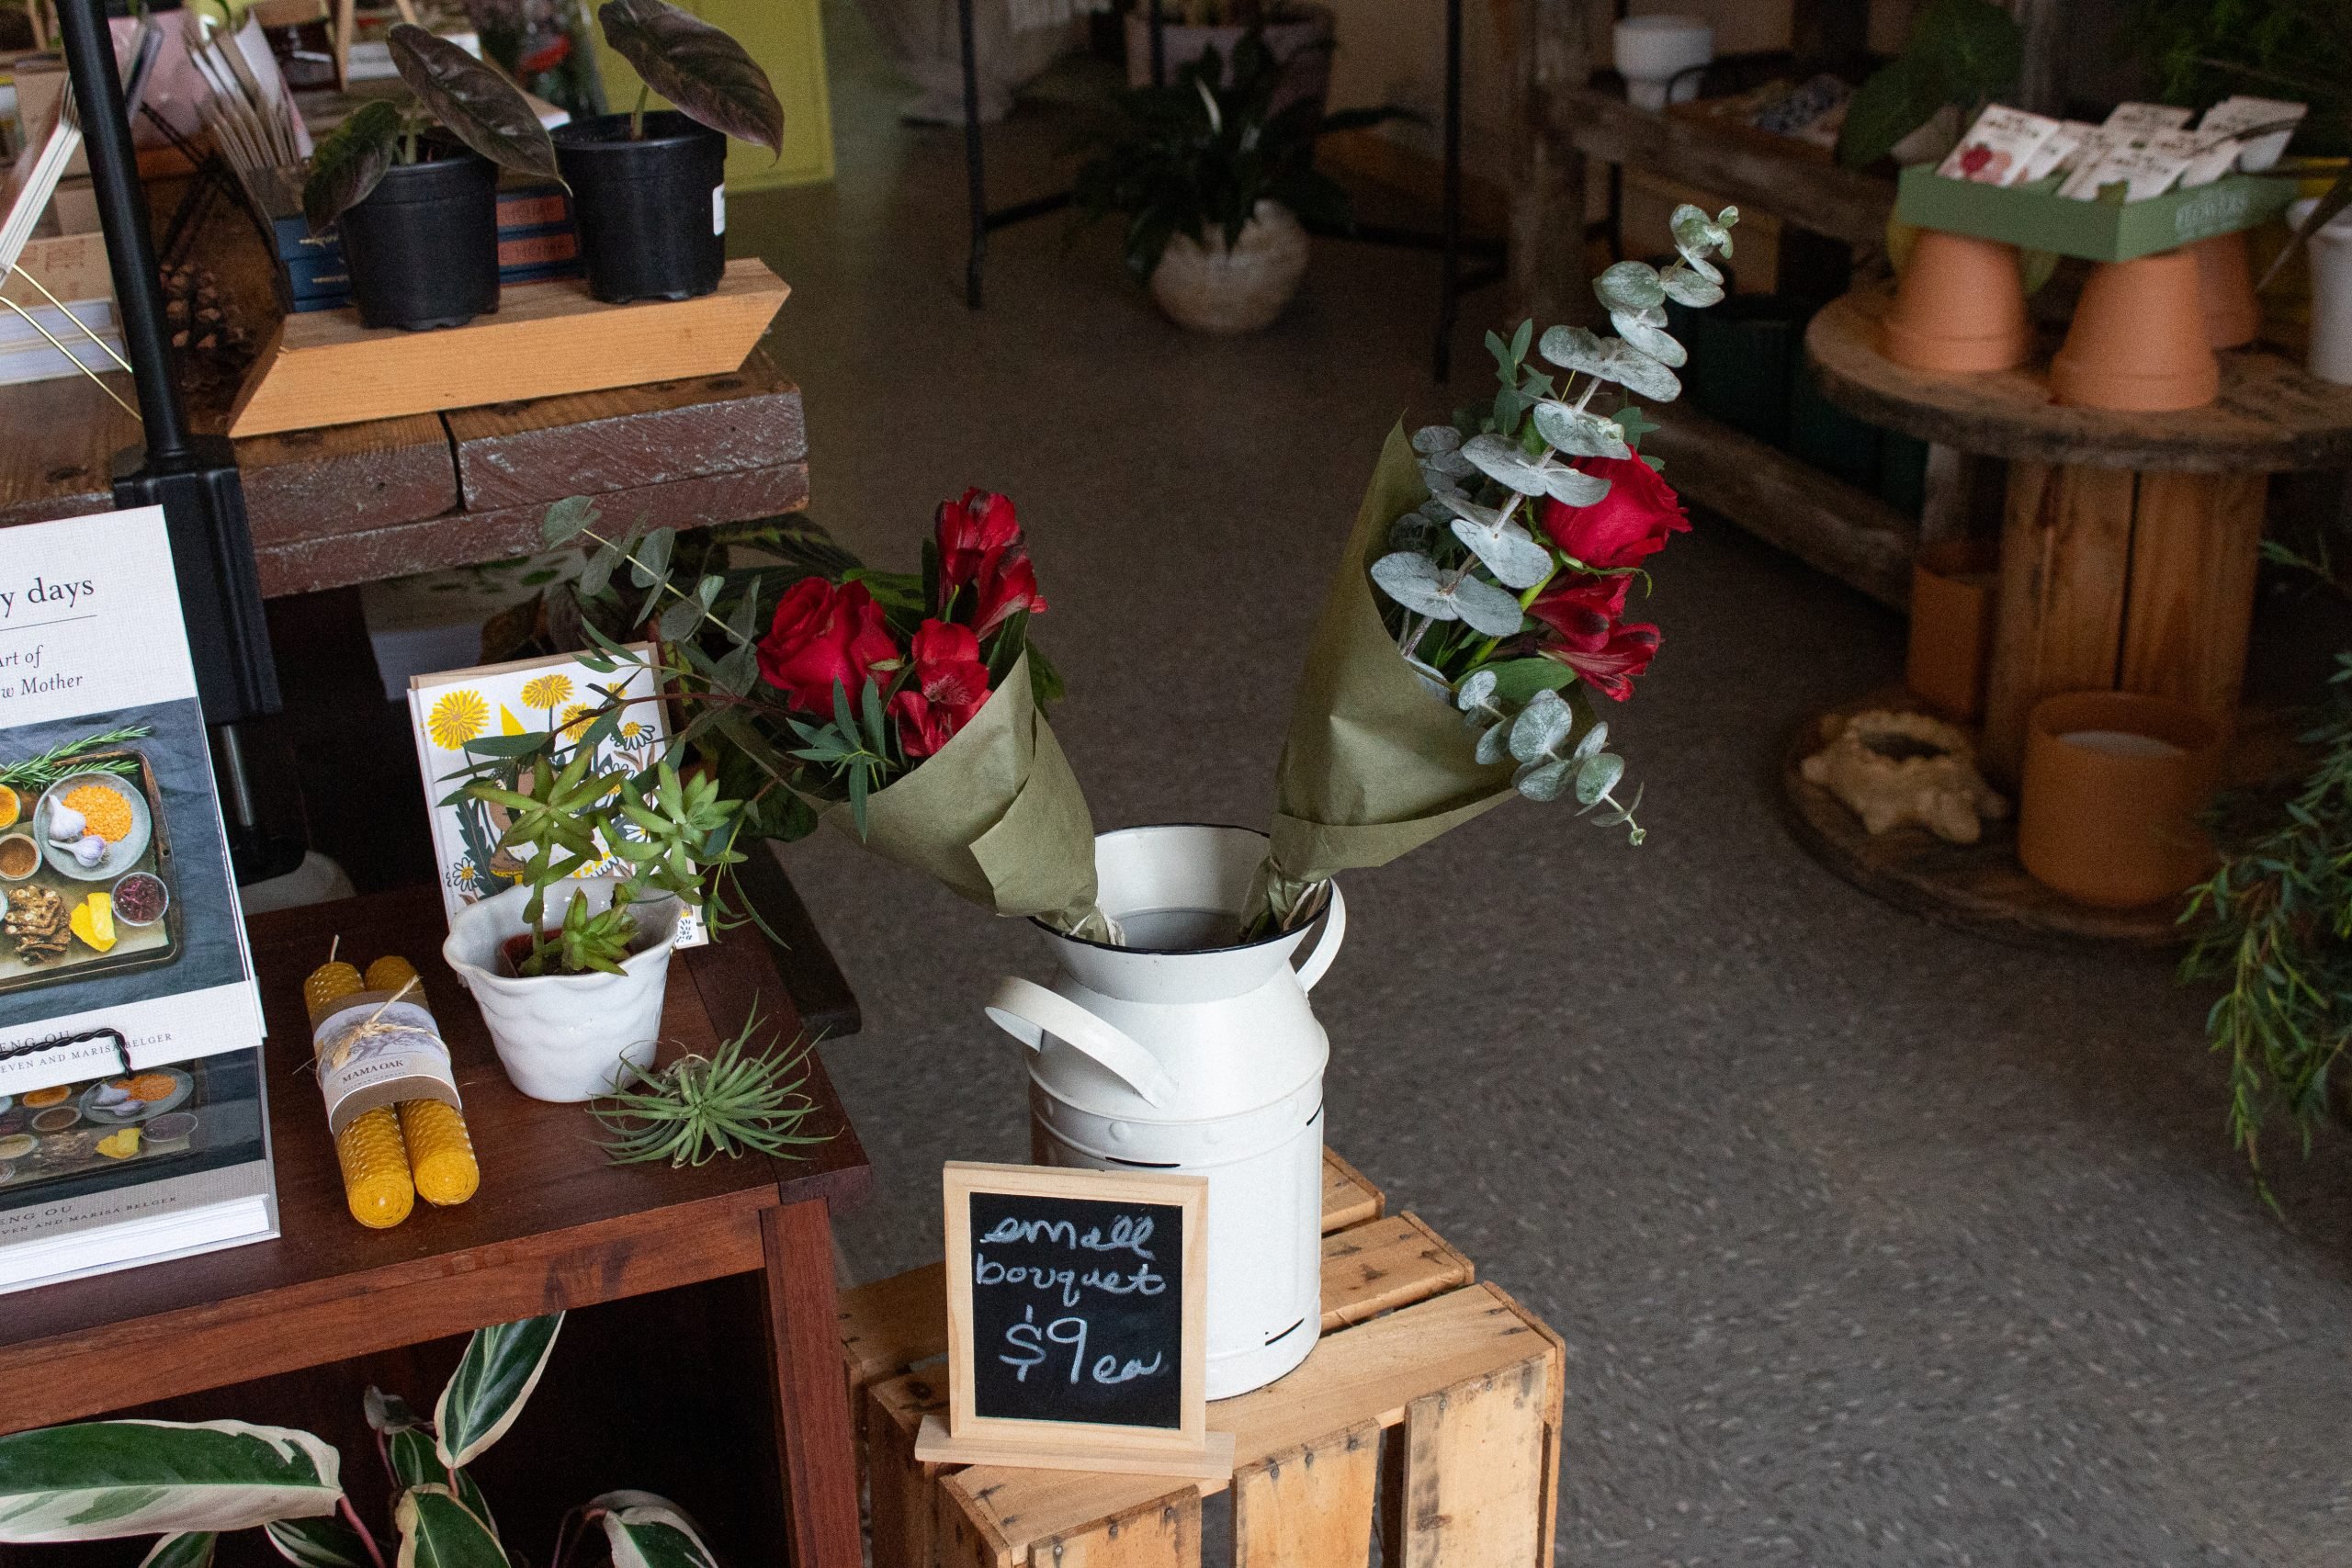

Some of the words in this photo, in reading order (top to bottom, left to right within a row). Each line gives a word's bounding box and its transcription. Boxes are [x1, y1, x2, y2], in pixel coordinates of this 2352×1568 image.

[28, 577, 95, 608] days
[25, 644, 43, 669] of
[21, 673, 84, 695] Mother
[1, 1059, 34, 1074] EVEN
[40, 1054, 66, 1066] AND
[72, 1043, 121, 1060] MARISA
[125, 1033, 173, 1049] BELGER
[343, 1066, 378, 1083] MAMA
[379, 1059, 404, 1070] OAK
[35, 1219, 63, 1229] AND
[69, 1208, 120, 1222] MARISA
[127, 1196, 177, 1211] BELGER
[45, 1205, 73, 1216] OU
[976, 1252, 1166, 1307] bouquet
[999, 1304, 1087, 1384] $9
